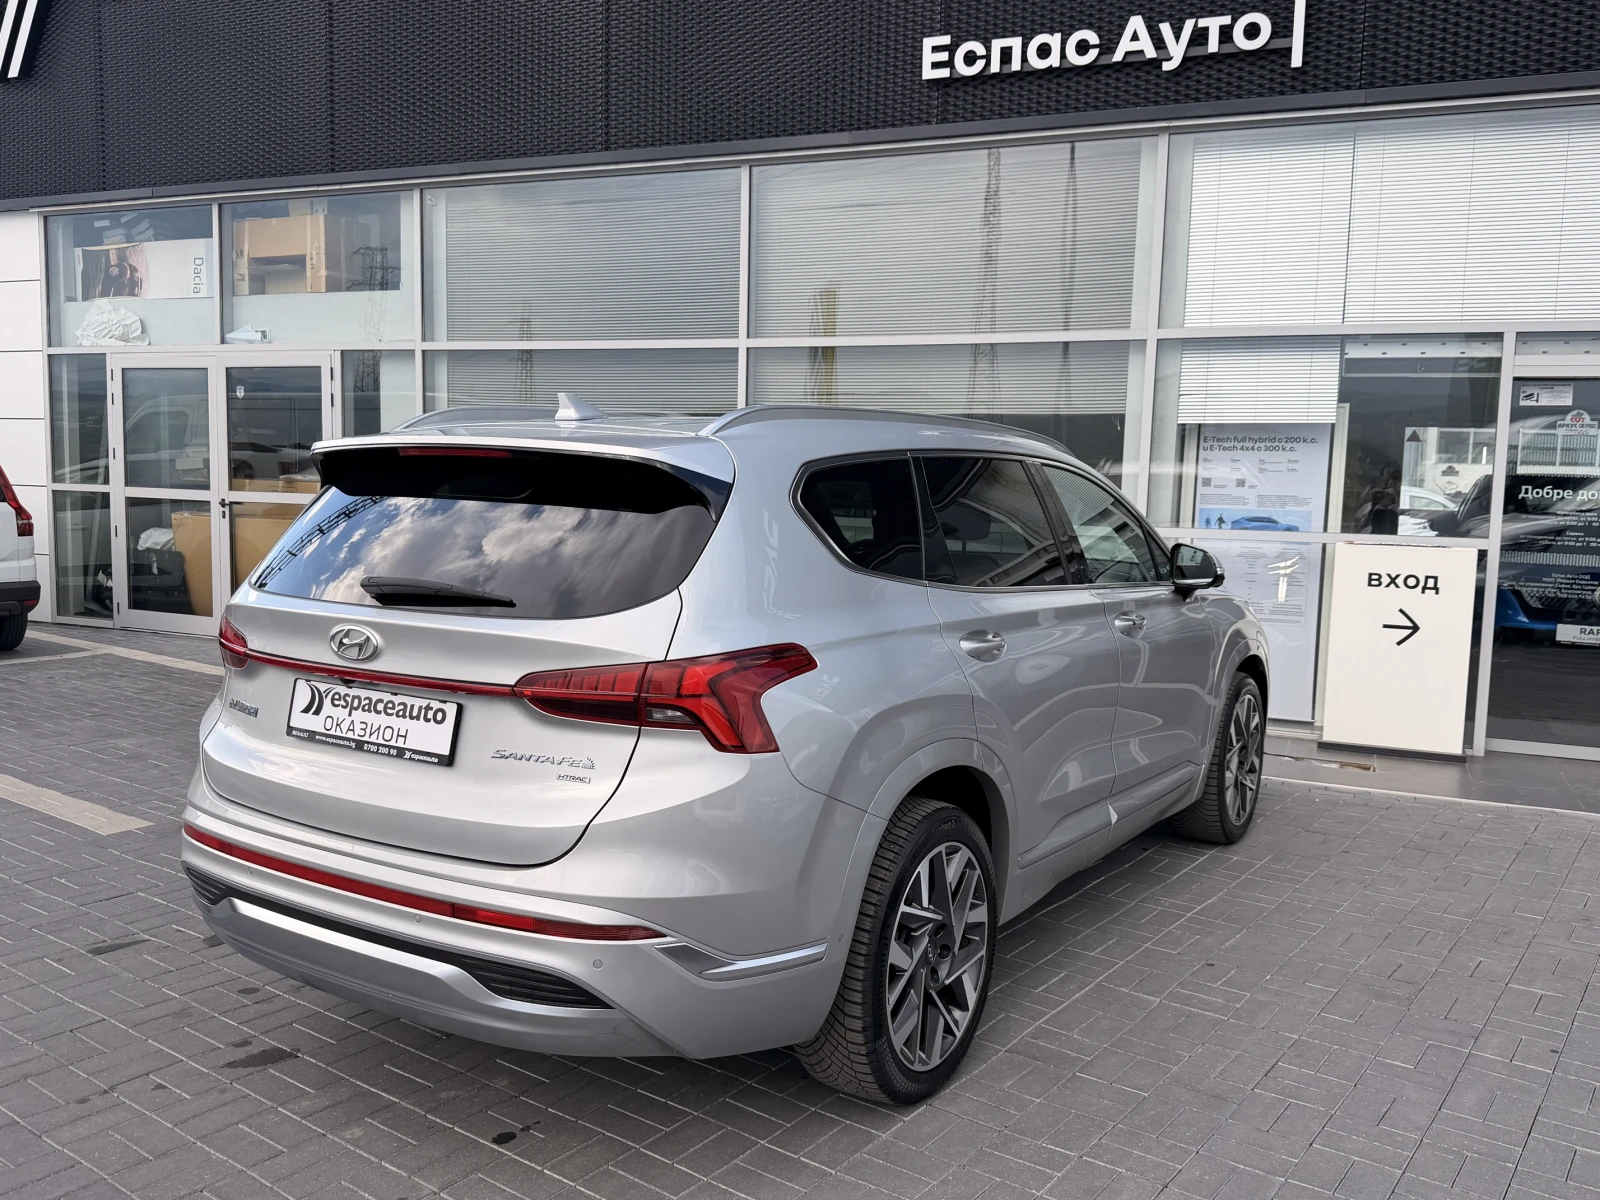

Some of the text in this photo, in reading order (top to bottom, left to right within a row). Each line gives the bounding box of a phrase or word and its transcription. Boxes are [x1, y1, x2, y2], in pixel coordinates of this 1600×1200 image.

[922, 12, 1272, 81] Еспас Ауто
[192, 257, 204, 294] Dacia
[1209, 444, 1238, 452] E-Tech
[1248, 436, 1276, 445] hybrid
[1284, 436, 1301, 444] 200
[1518, 485, 1600, 502] Добре до
[330, 690, 447, 725] espaceauto
[323, 715, 409, 745] ОКАЗИОН
[364, 743, 378, 752] 0700
[378, 746, 389, 755] 200
[411, 753, 439, 763] espaceauto
[557, 773, 588, 783] HTRAC
